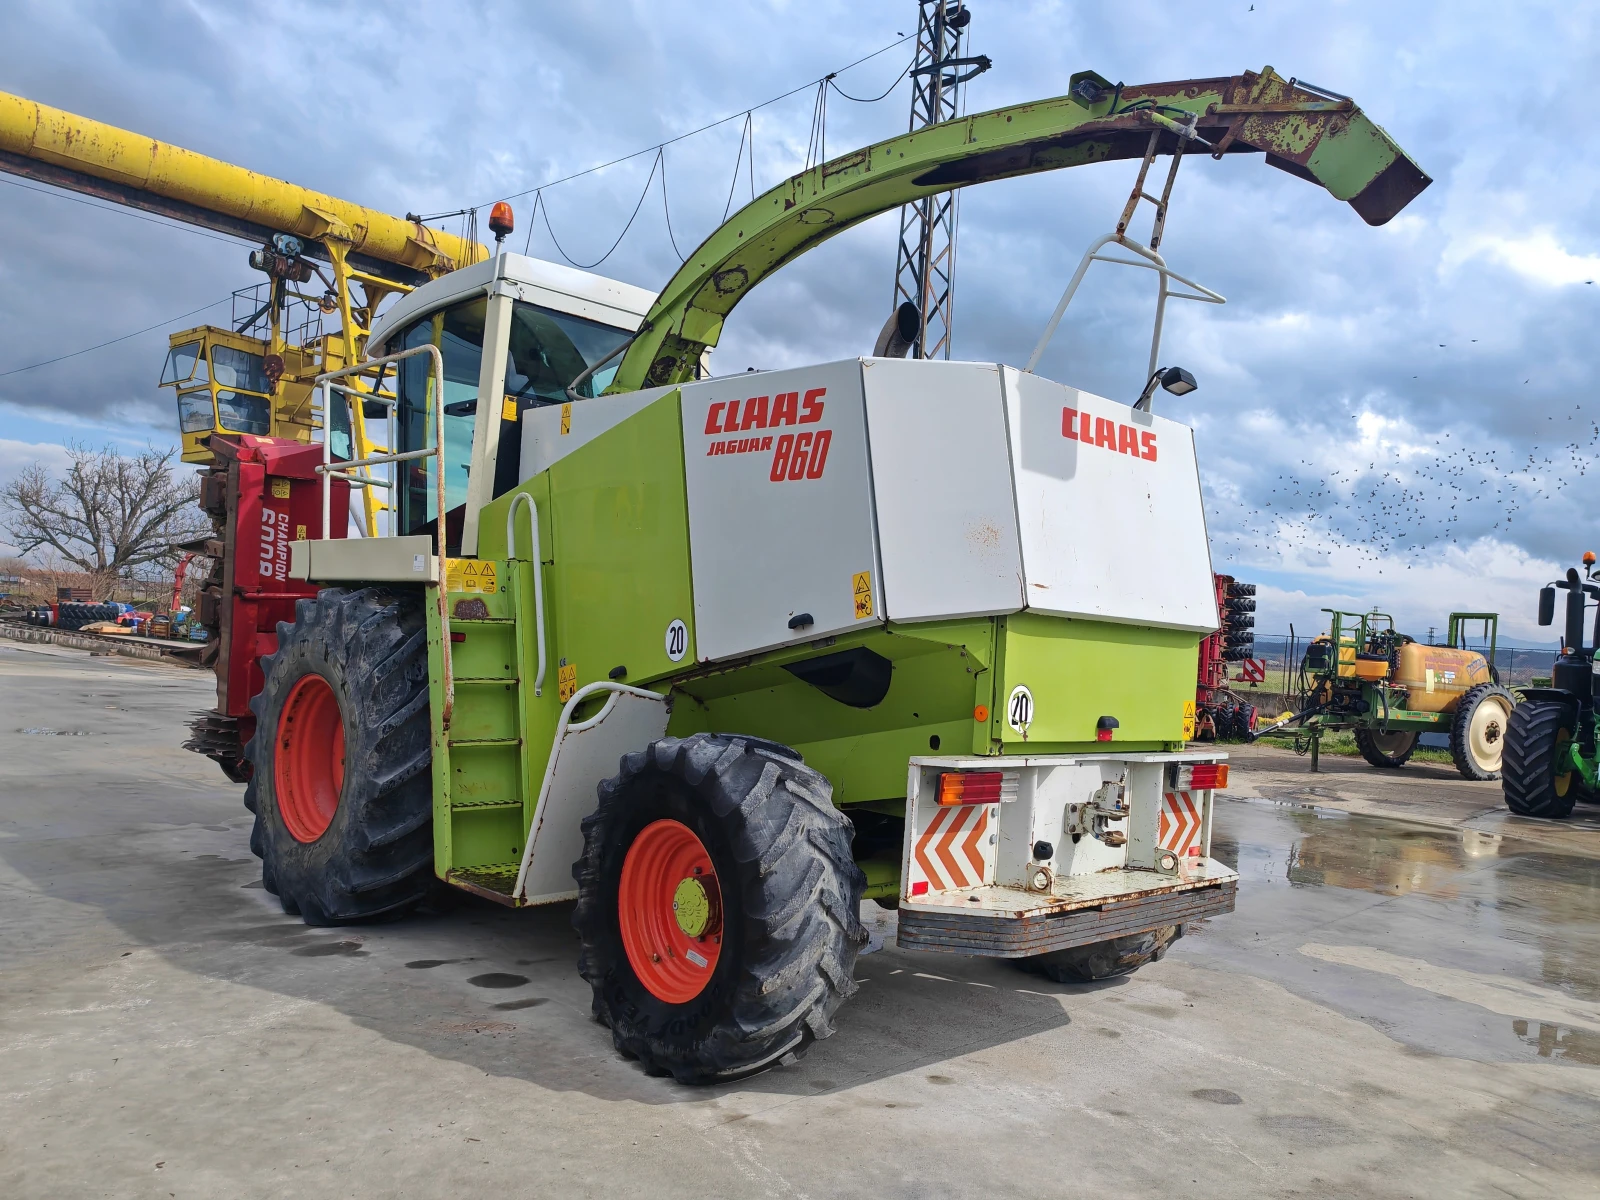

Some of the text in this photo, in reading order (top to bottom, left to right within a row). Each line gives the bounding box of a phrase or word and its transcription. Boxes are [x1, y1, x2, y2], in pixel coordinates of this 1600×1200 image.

[705, 388, 826, 434] CLAAS
[1062, 407, 1157, 462] CLAAS
[707, 430, 832, 482] JAGUAR 860
[275, 513, 289, 582] CHAMPION
[669, 625, 684, 654] 20
[1011, 694, 1029, 725] 20
